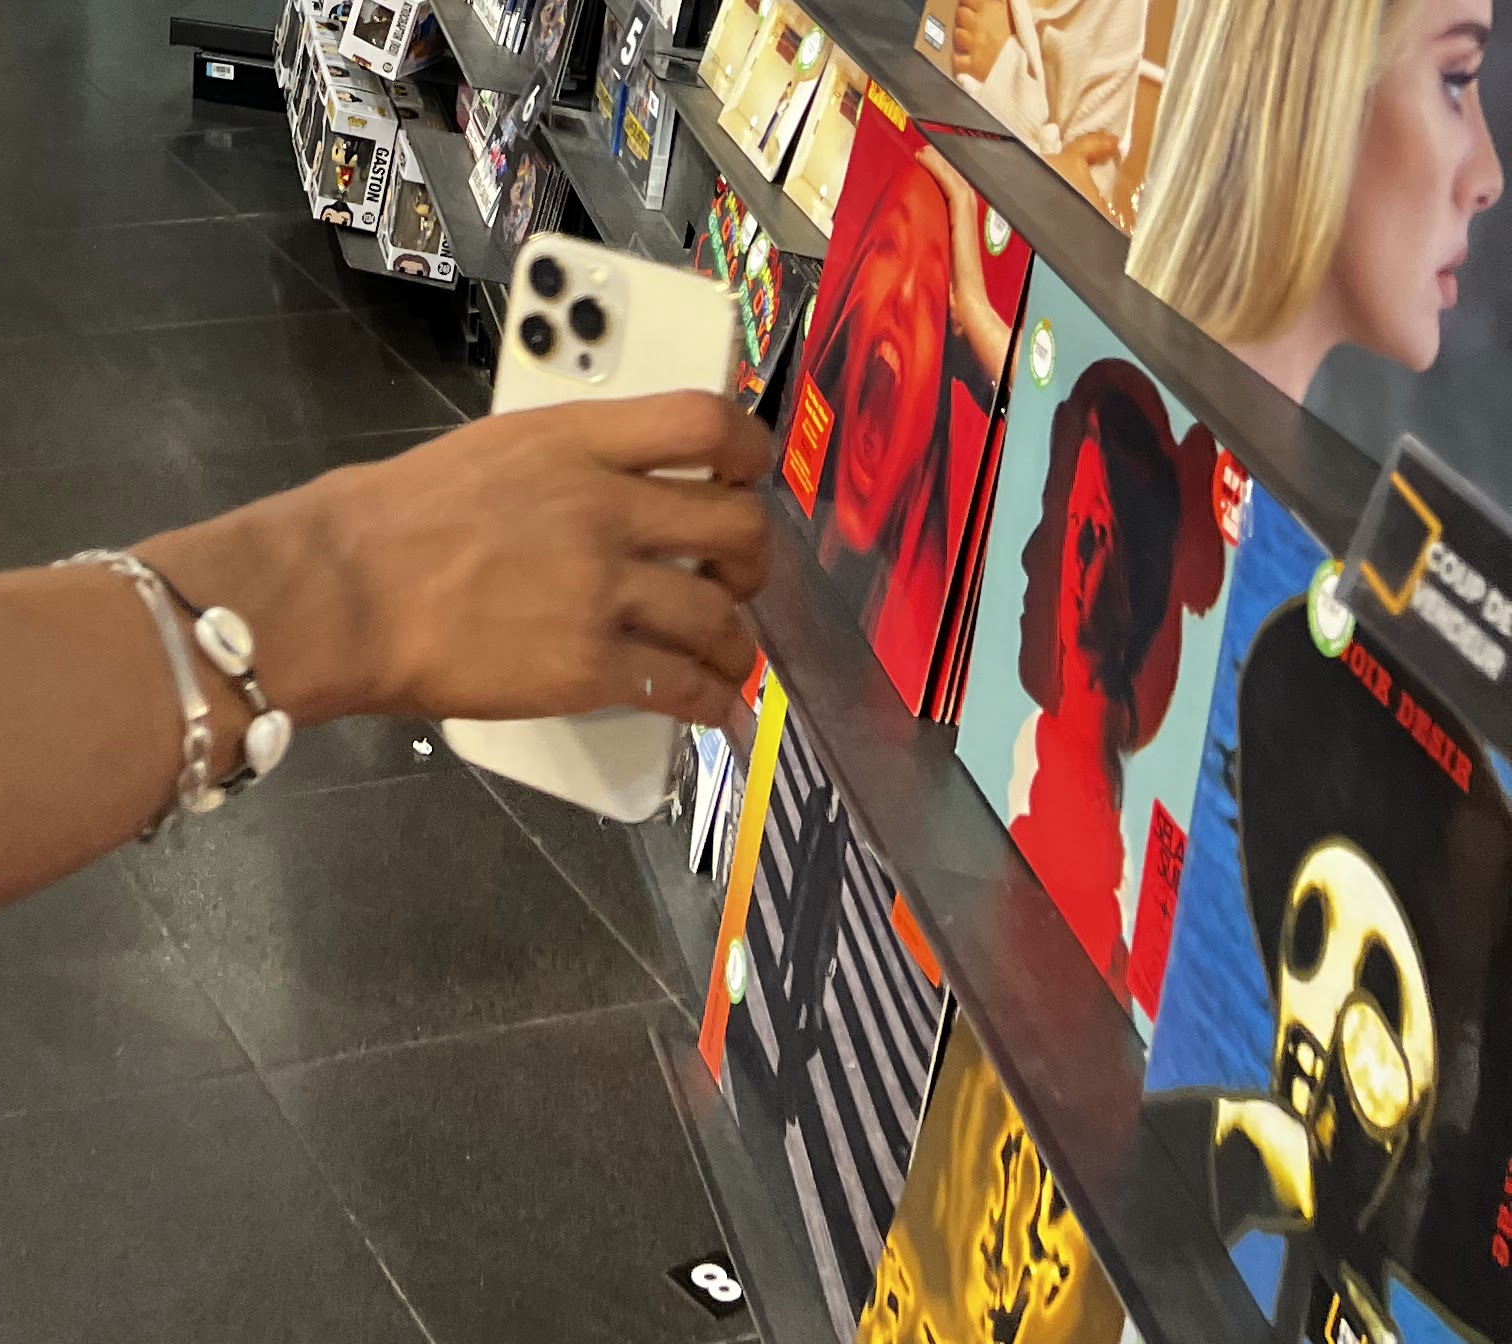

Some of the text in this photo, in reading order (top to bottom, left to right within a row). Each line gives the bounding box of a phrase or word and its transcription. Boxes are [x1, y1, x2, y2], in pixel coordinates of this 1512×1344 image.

[619, 16, 644, 66] 5
[521, 84, 541, 123] 6
[366, 146, 390, 204] GASTON
[690, 1262, 743, 1303] 8
